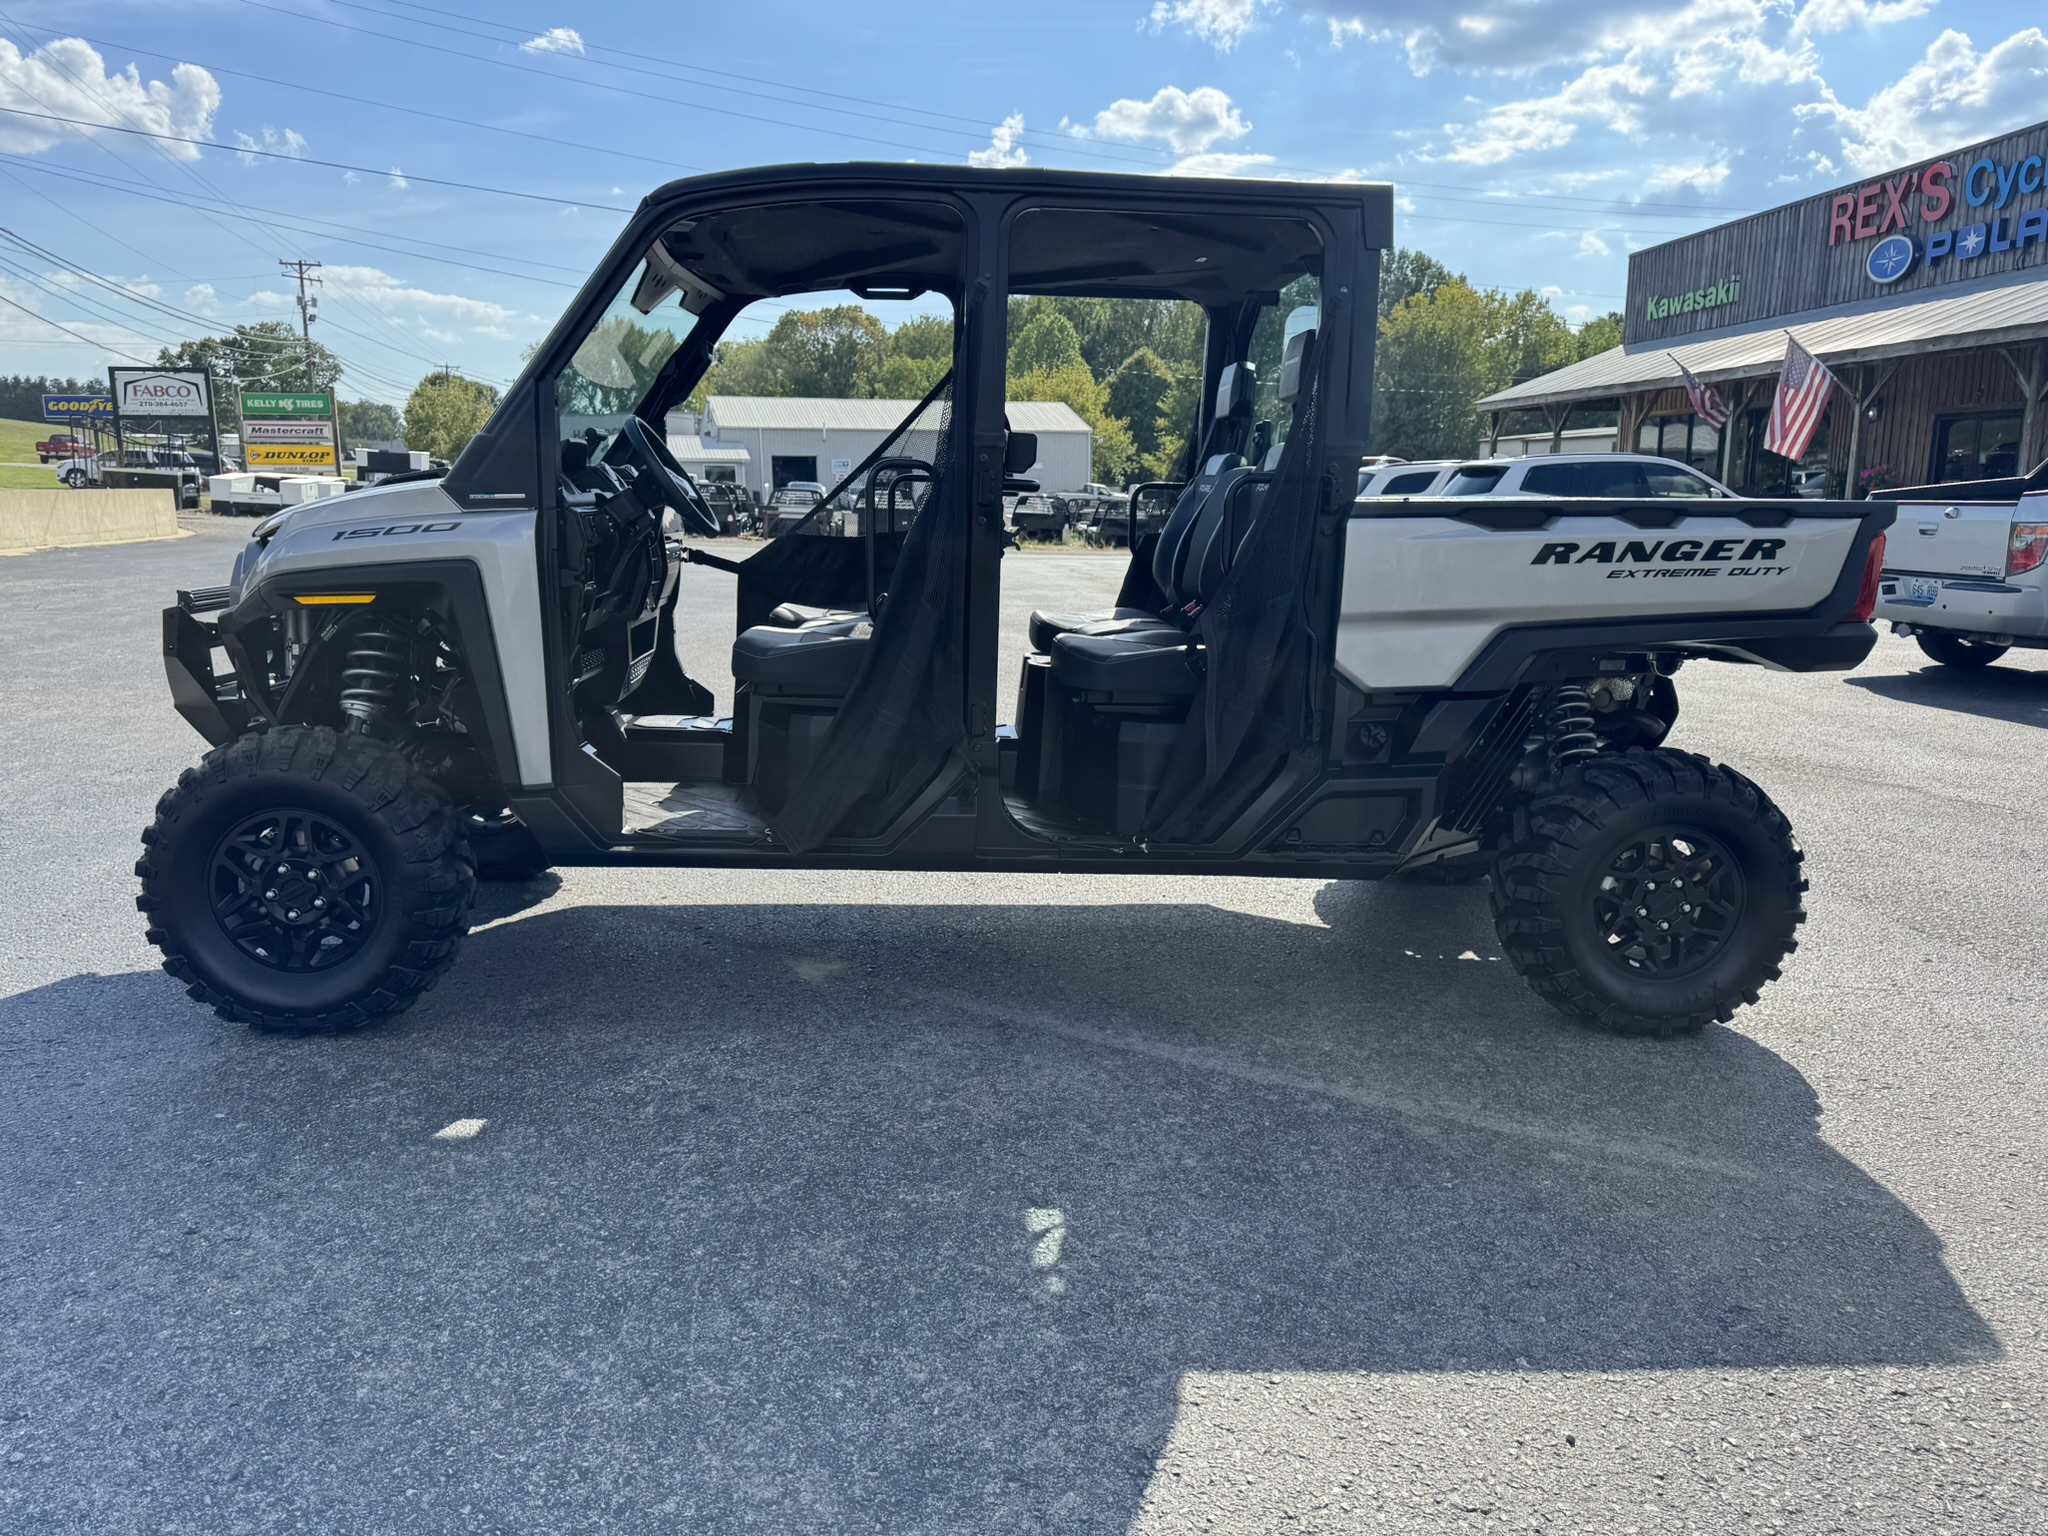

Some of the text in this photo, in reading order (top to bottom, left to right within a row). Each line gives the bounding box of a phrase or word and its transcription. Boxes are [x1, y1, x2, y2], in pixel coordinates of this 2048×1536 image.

[1828, 161, 1953, 247] REX'S
[1647, 274, 1740, 321] Kawasaki
[132, 384, 191, 398] FABCO
[246, 399, 324, 408] KELLY TIRES
[250, 426, 324, 436] Mastercraft
[263, 451, 331, 460] DUNLOP
[331, 521, 463, 541] 1500
[1530, 538, 1787, 566] RANGER
[1605, 565, 1792, 580] EXTREME DUTY
